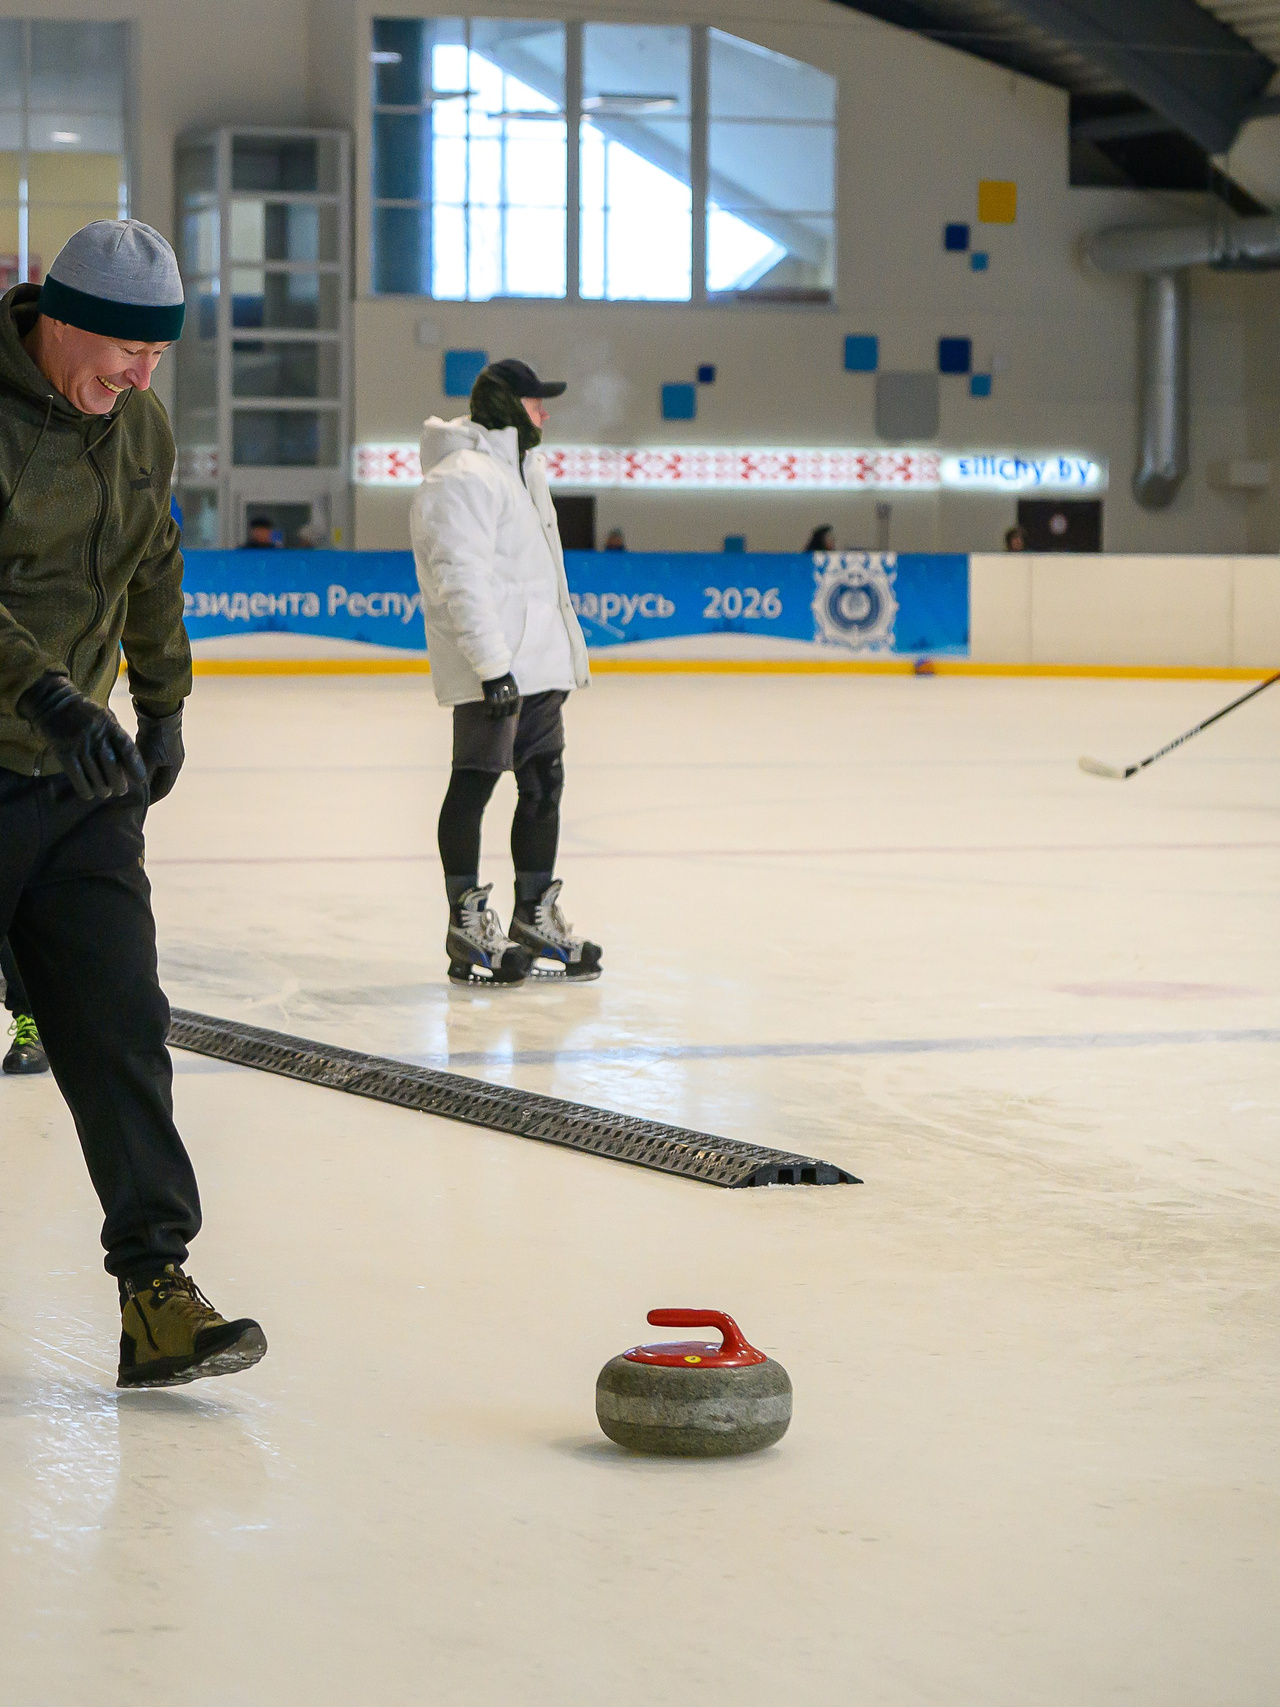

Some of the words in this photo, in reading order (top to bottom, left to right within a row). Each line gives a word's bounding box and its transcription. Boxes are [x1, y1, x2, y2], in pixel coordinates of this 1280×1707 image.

[182, 592, 320, 621] езидента
[326, 584, 425, 624] Респу
[703, 587, 783, 619] 2026
